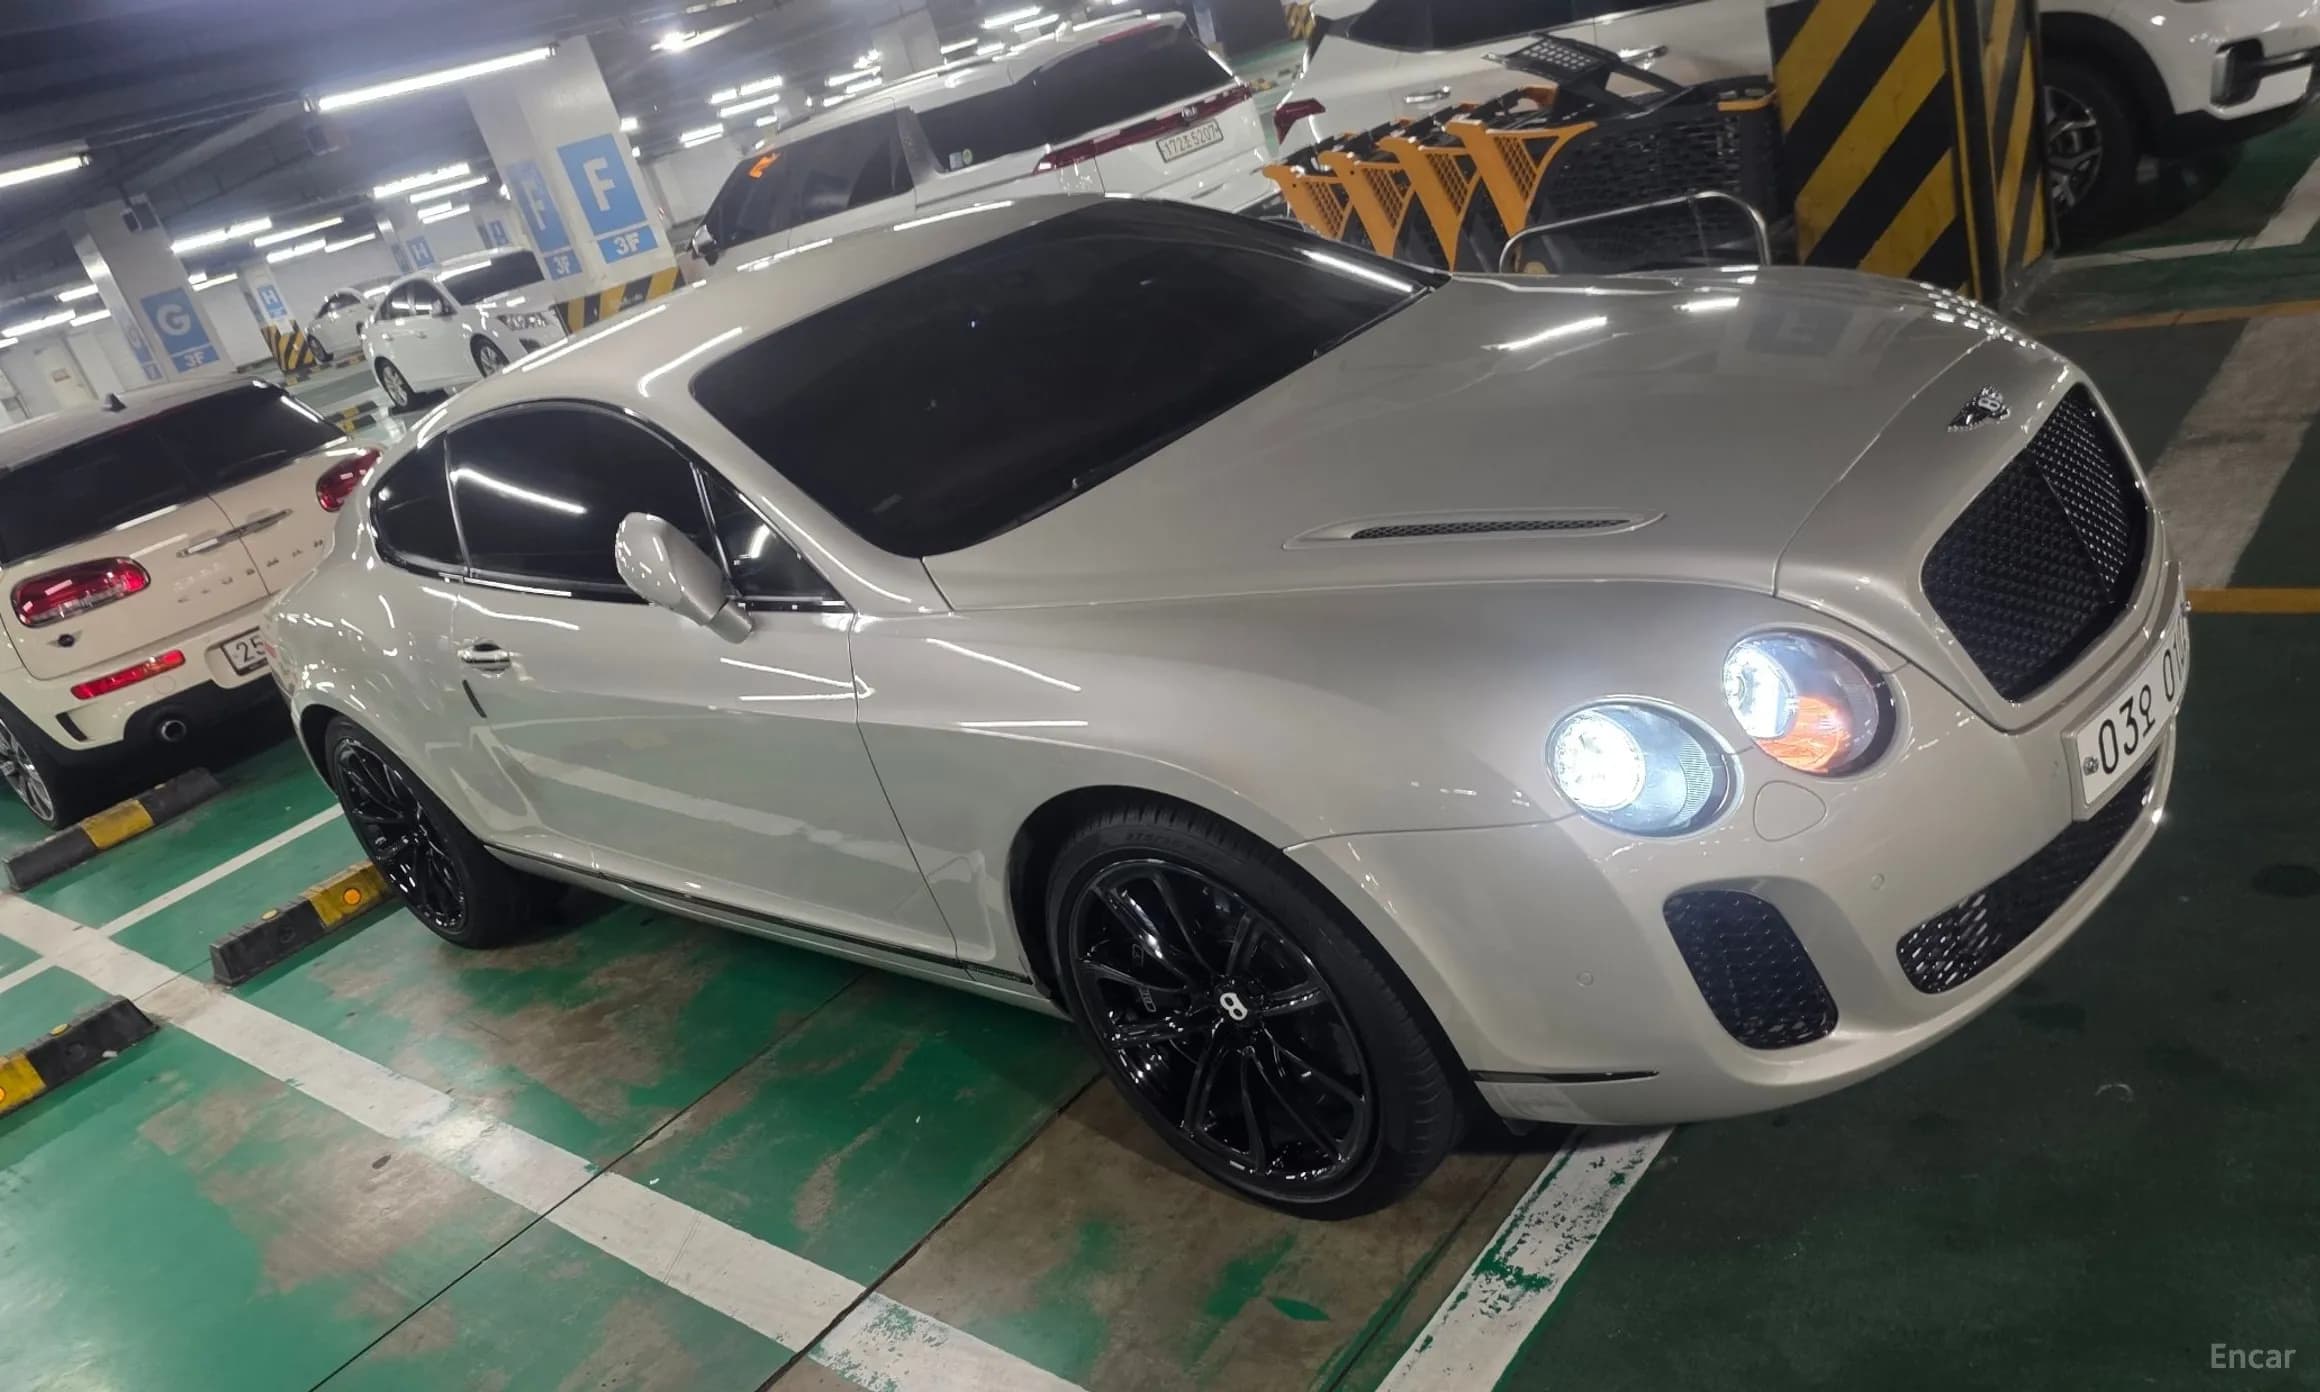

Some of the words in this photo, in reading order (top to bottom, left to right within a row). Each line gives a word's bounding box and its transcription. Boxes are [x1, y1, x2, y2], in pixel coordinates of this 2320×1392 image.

[584, 157, 615, 211] F
[522, 180, 546, 230] F
[614, 232, 640, 255] 3F
[553, 255, 572, 274] 3F
[262, 289, 279, 304] H
[158, 304, 191, 336] G
[184, 351, 205, 367] 3F
[236, 635, 266, 663] 25
[2099, 684, 2156, 775] 03오
[1220, 992, 1248, 1020] B
